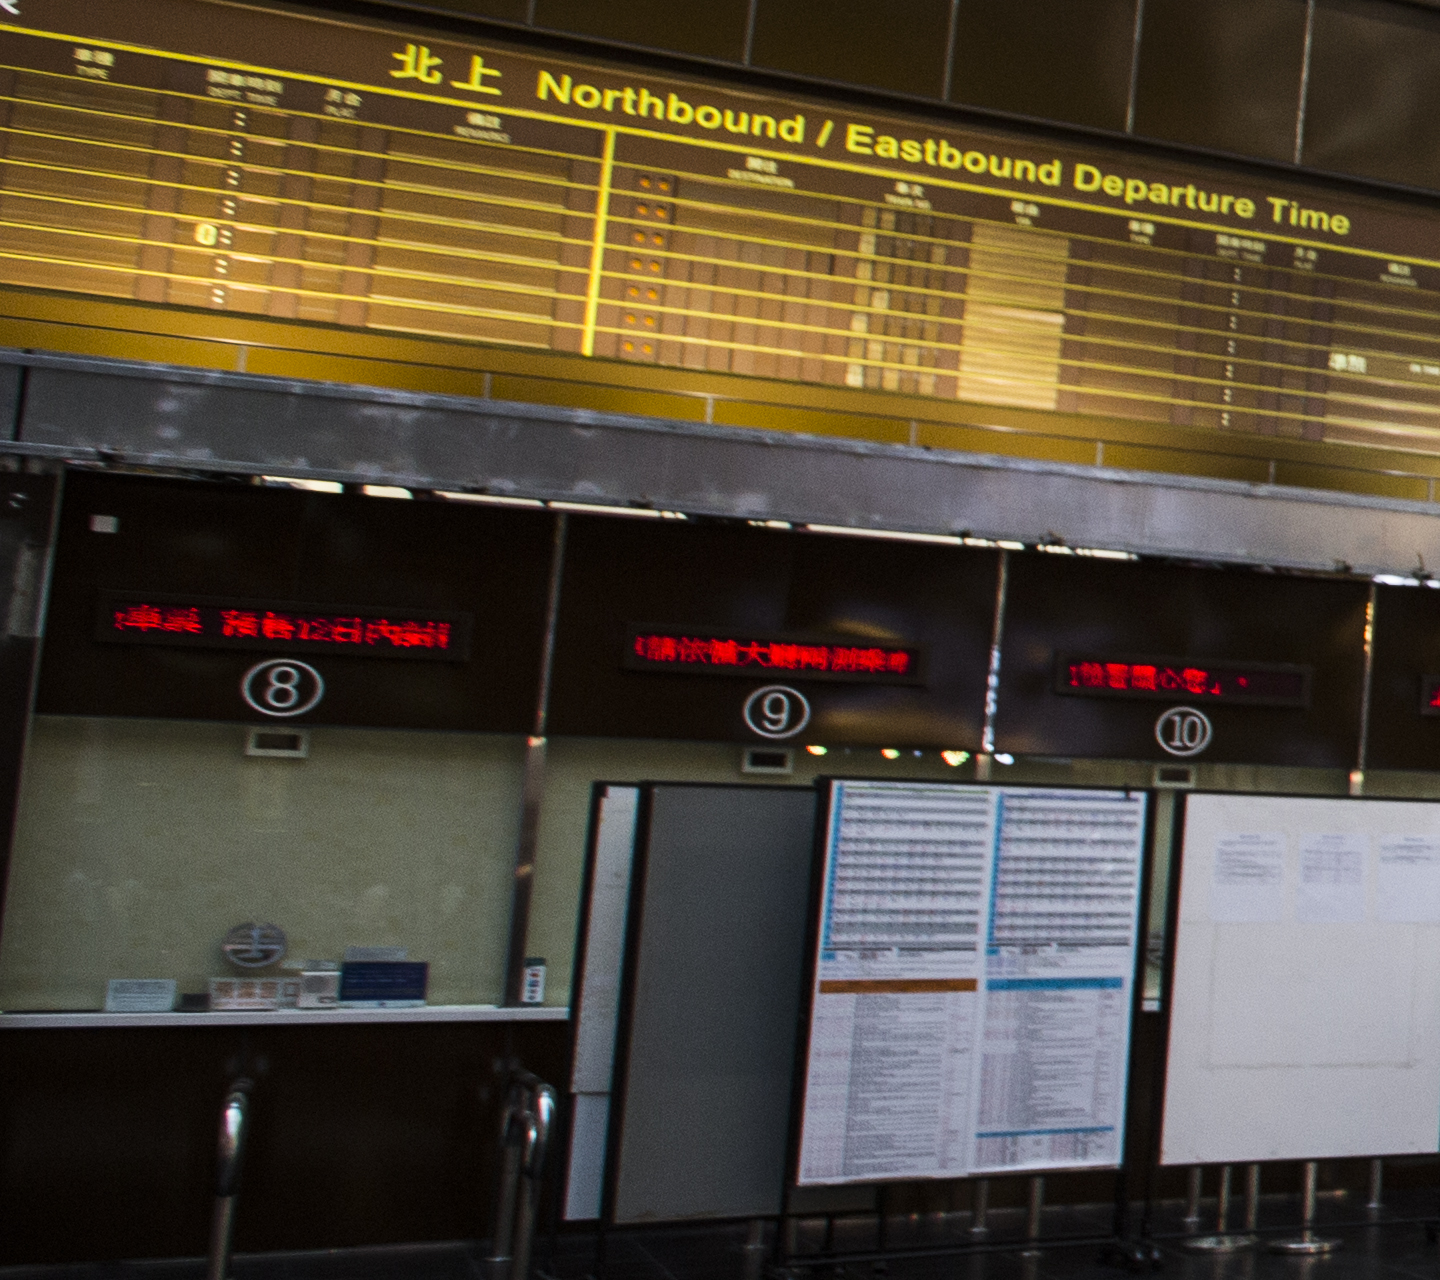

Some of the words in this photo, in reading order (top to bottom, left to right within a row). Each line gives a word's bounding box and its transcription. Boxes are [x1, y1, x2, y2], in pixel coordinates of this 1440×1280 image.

[389, 43, 502, 96] 北上
[537, 70, 806, 144] Northbound
[846, 124, 1062, 187] Eastbound
[1074, 163, 1256, 219] Departure
[1268, 197, 1351, 236] Time
[1170, 715, 1201, 748] 10
